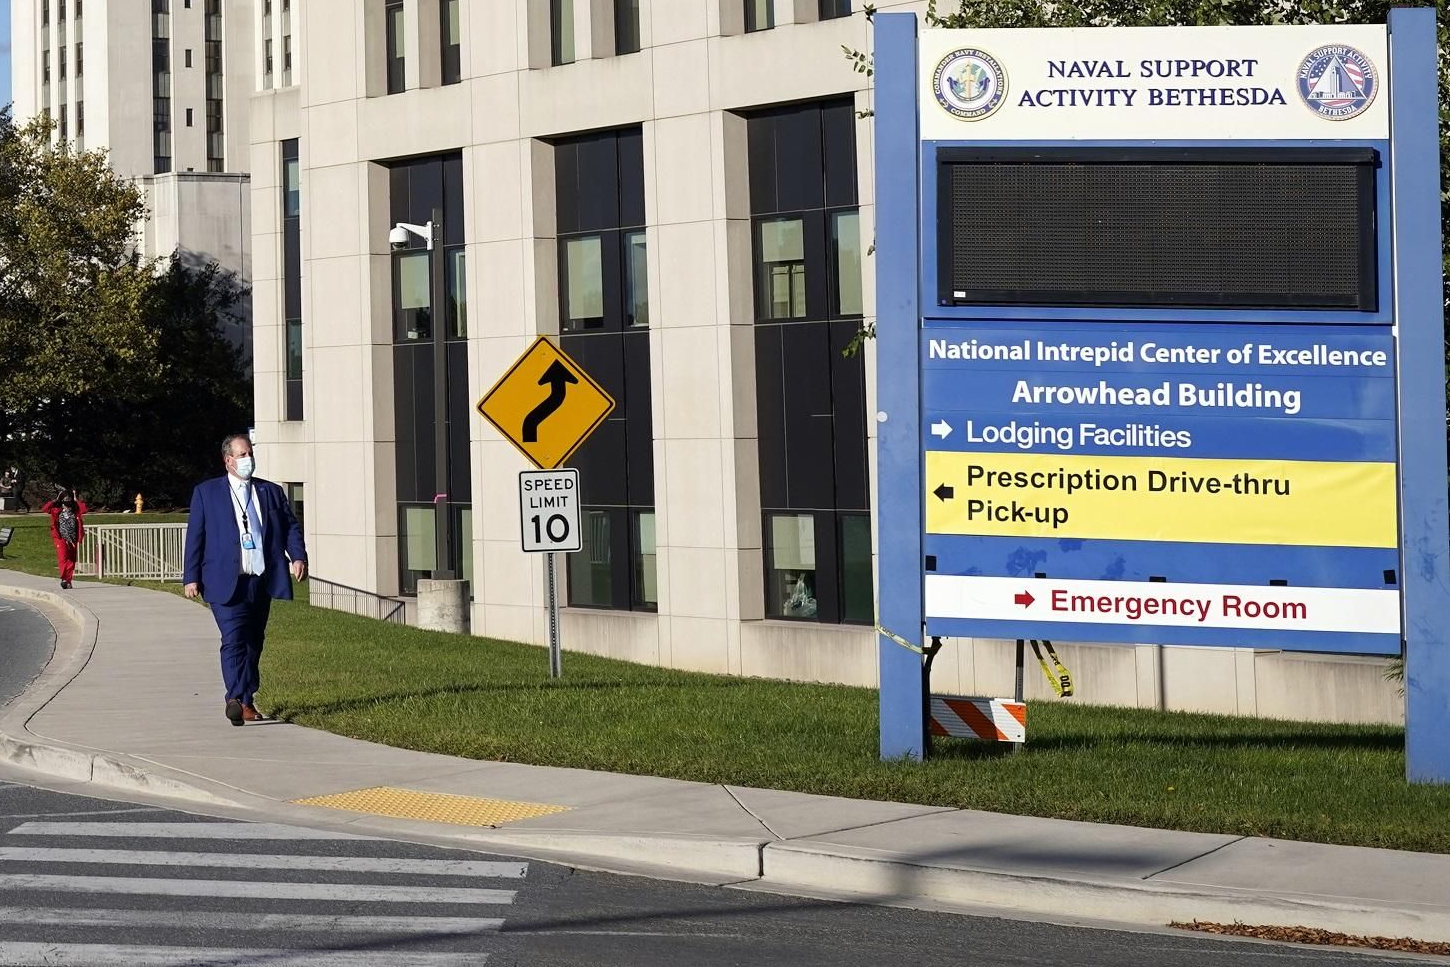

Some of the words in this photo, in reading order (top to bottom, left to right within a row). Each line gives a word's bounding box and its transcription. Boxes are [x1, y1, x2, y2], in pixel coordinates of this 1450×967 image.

[934, 54, 955, 94] COMMANDER
[1048, 61, 1131, 77] NAVAL
[1141, 60, 1258, 77] SUPPORT
[1300, 57, 1316, 79] NAVAL
[1313, 47, 1347, 60] SUPPORT
[1347, 50, 1372, 79] ACTIVITY
[1018, 89, 1137, 107] ACTIVITY
[1148, 88, 1286, 105] BETHESDA
[1318, 105, 1358, 116] BETHESDA
[950, 108, 986, 117] COMMAND
[930, 340, 1030, 359] National
[1038, 342, 1133, 366] Intrepid
[1140, 342, 1221, 363] Center
[1227, 344, 1252, 363] of
[1259, 345, 1386, 365] Excellence
[1012, 381, 1169, 405] Arrowhead
[1179, 383, 1300, 414] Building
[967, 421, 1072, 448] Lodging
[1080, 424, 1191, 447] Facilities
[525, 479, 573, 491] SPEED
[968, 466, 1136, 494] Prescription
[1149, 471, 1289, 495] Drive-thru
[531, 496, 568, 508] LIMIT
[968, 500, 1068, 528] Pick-up
[532, 514, 569, 543] 10
[1051, 589, 1211, 621] Emergency
[1223, 596, 1306, 618] Room
